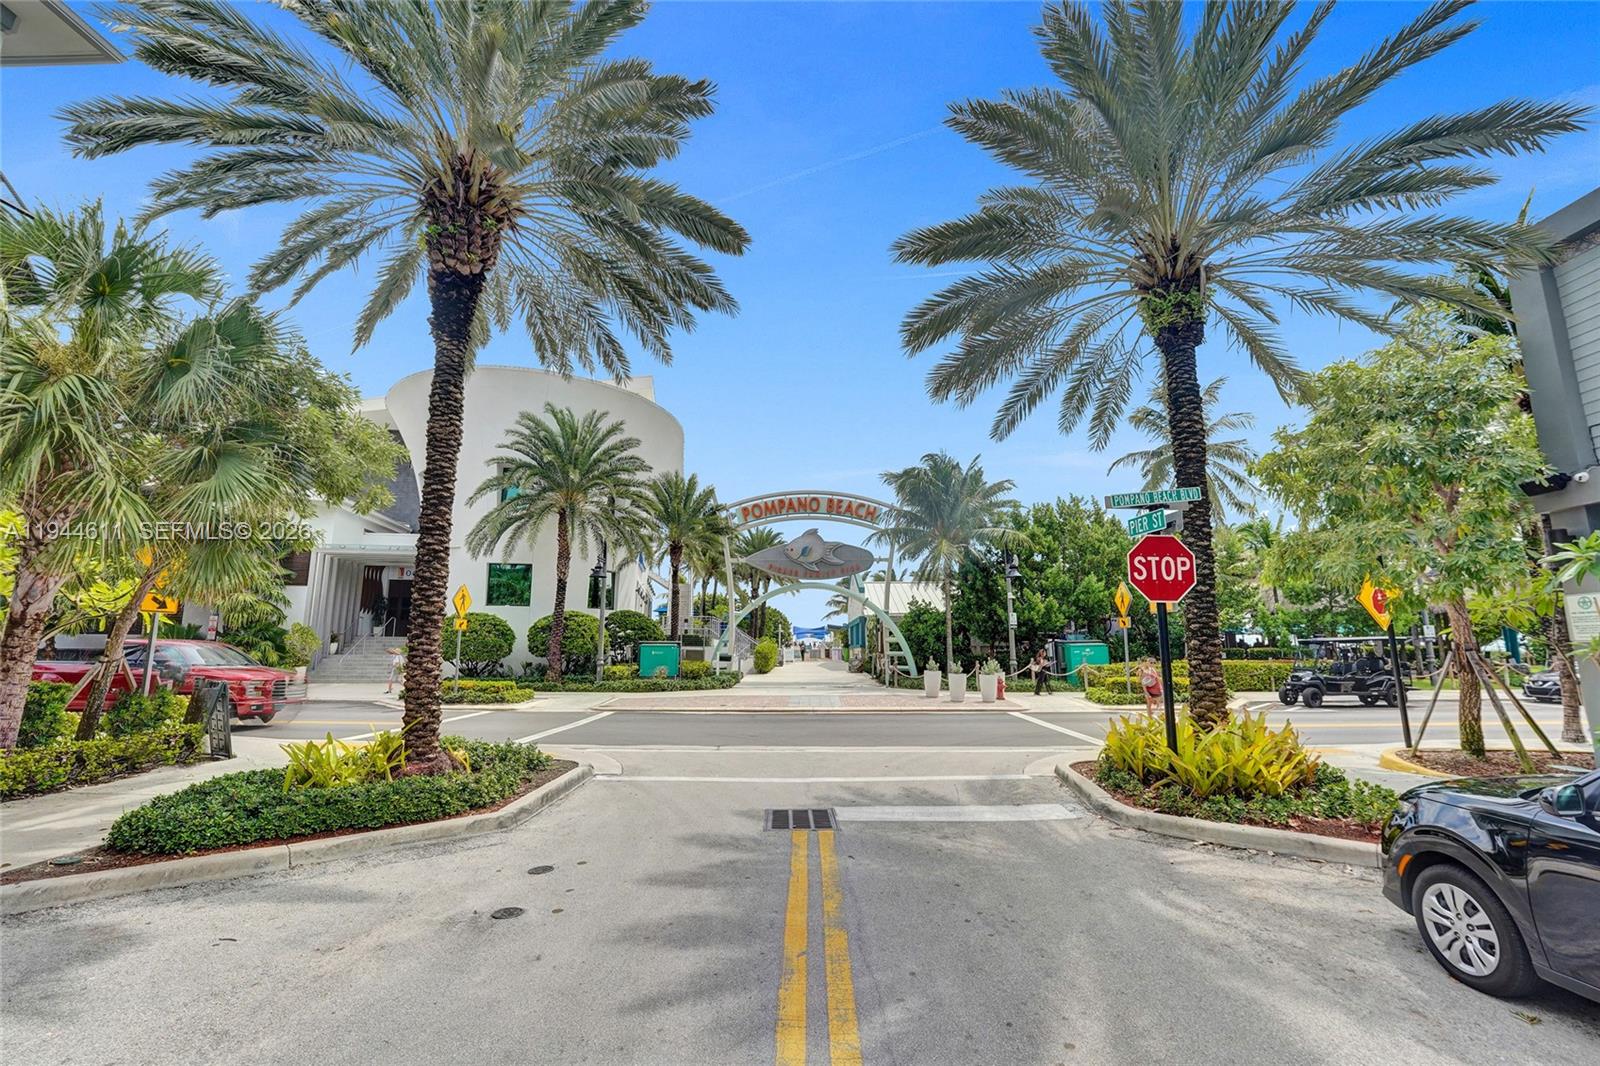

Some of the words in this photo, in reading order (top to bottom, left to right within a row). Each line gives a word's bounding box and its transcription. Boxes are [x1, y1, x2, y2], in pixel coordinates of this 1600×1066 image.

[741, 496, 820, 522] POMPANO
[826, 497, 878, 523] BEACH
[1113, 493, 1150, 506] POMPANO
[1154, 491, 1178, 503] BEACH
[1180, 489, 1199, 501] BLVD
[1129, 515, 1149, 535] PIER
[1152, 511, 1163, 528] ST
[1133, 555, 1191, 581] STOP
